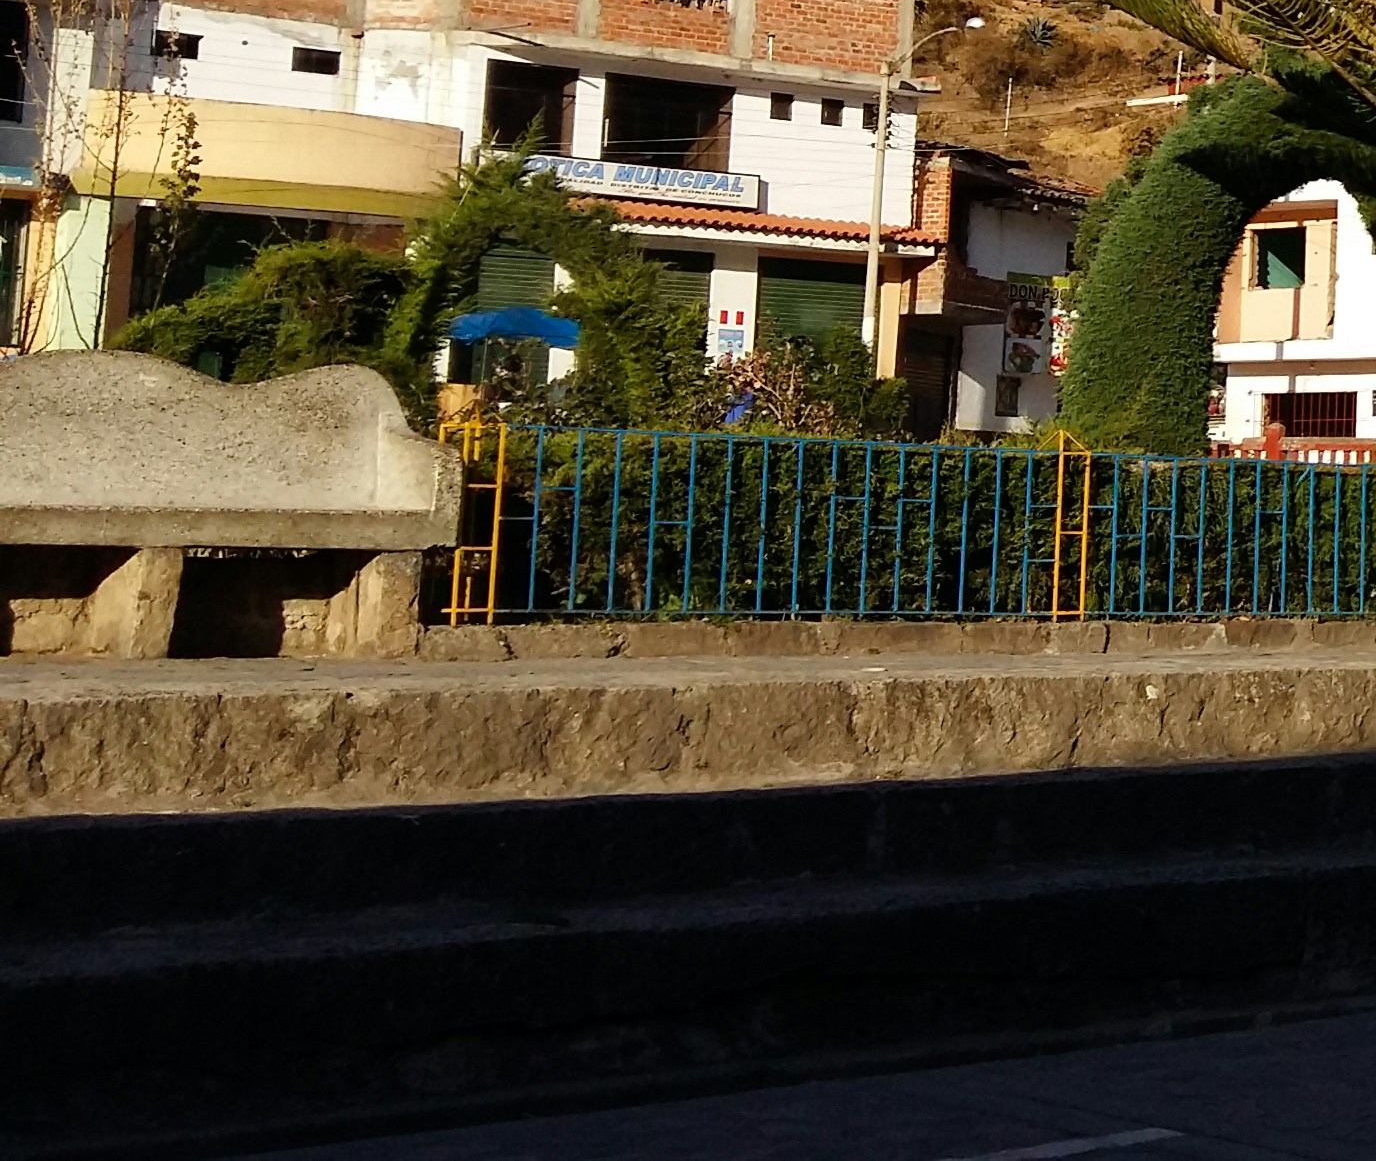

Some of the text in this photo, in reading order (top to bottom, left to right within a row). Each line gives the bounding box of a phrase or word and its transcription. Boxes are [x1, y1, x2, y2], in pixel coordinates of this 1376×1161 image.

[524, 156, 744, 192] OTICA MUNICIPAL
[681, 189, 741, 198] CONCHUCOS
[1009, 283, 1038, 300] DON
